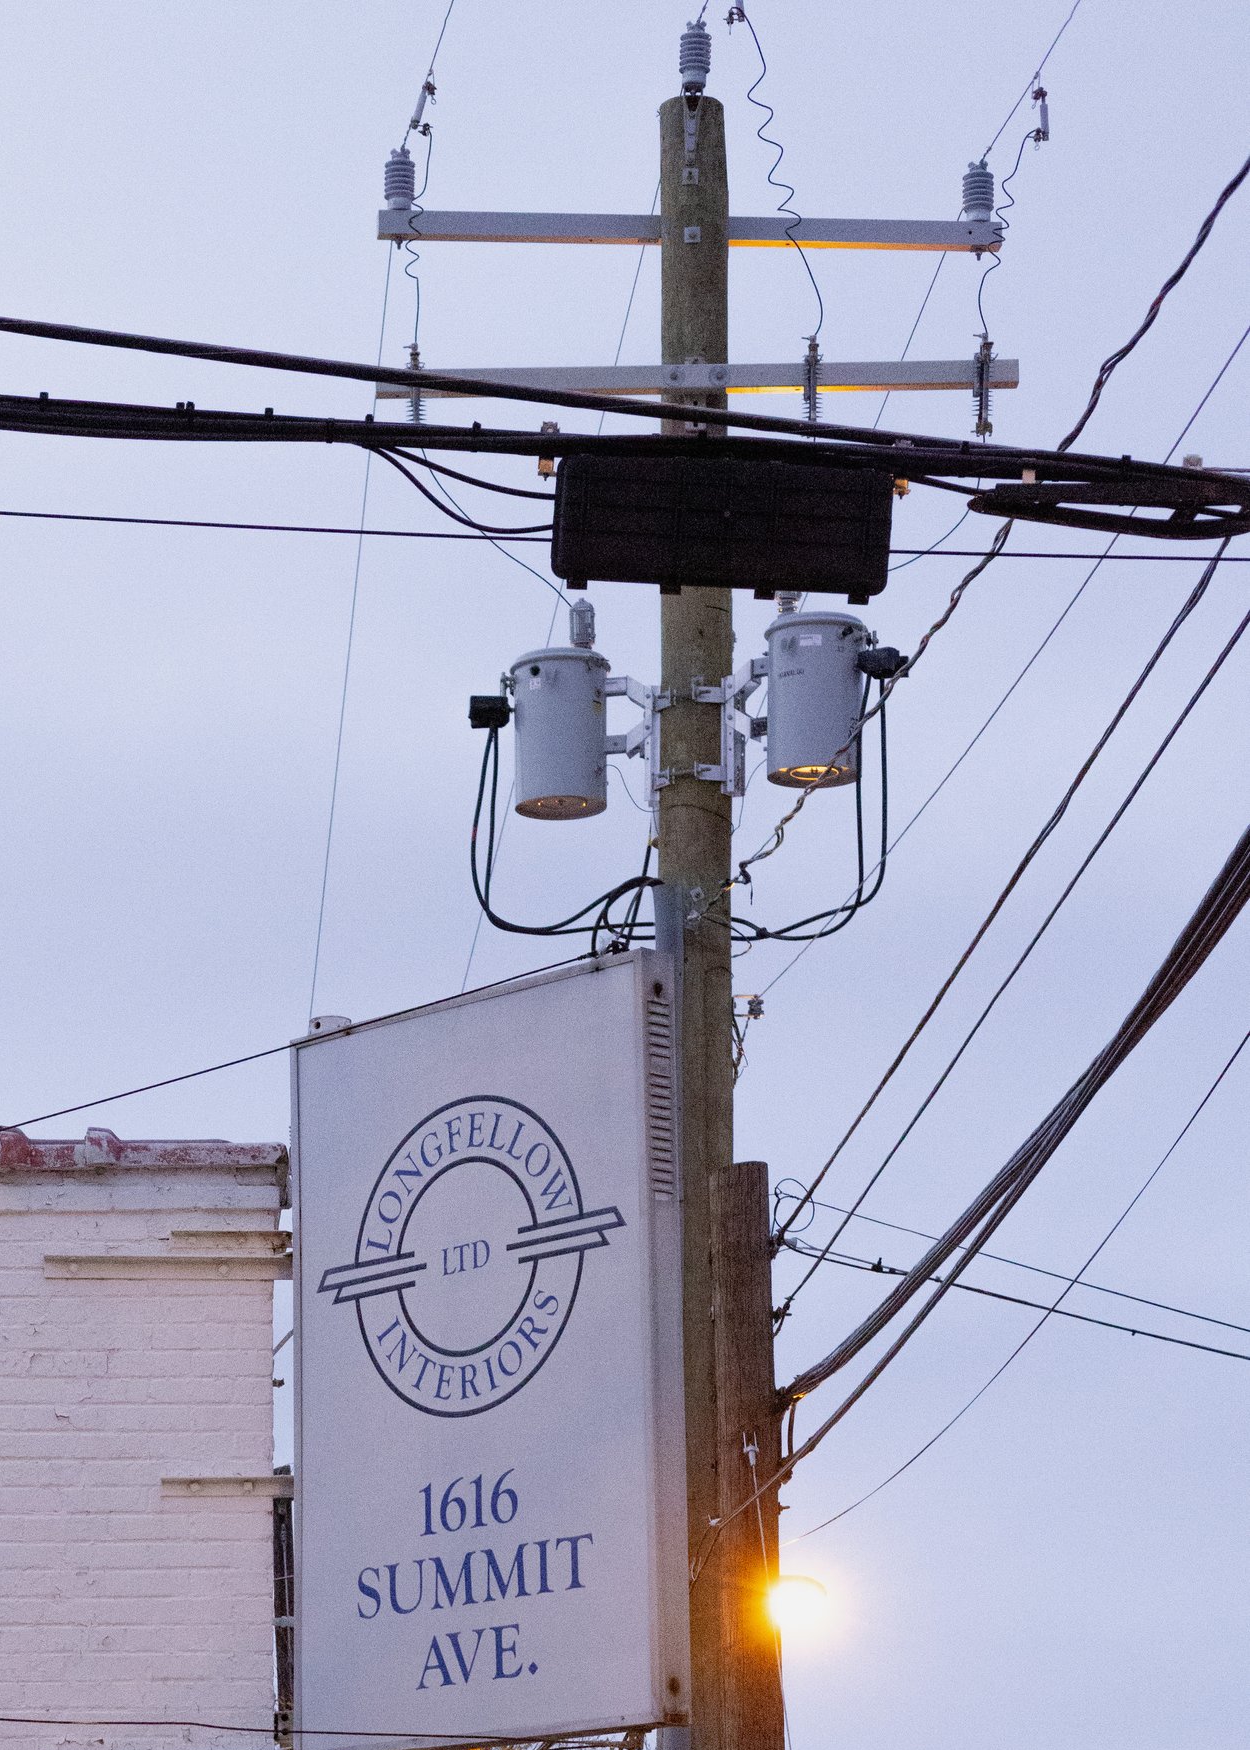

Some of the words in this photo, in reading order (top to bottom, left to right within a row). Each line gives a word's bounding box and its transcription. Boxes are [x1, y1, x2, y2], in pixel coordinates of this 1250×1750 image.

[366, 1111, 573, 1254] LONGFELLOW
[441, 1239, 491, 1276] LTD
[376, 1289, 559, 1401] INTERIORS
[419, 1468, 519, 1537] 1616
[356, 1532, 594, 1620] SUMMIT
[416, 1623, 539, 1691] AVE.
